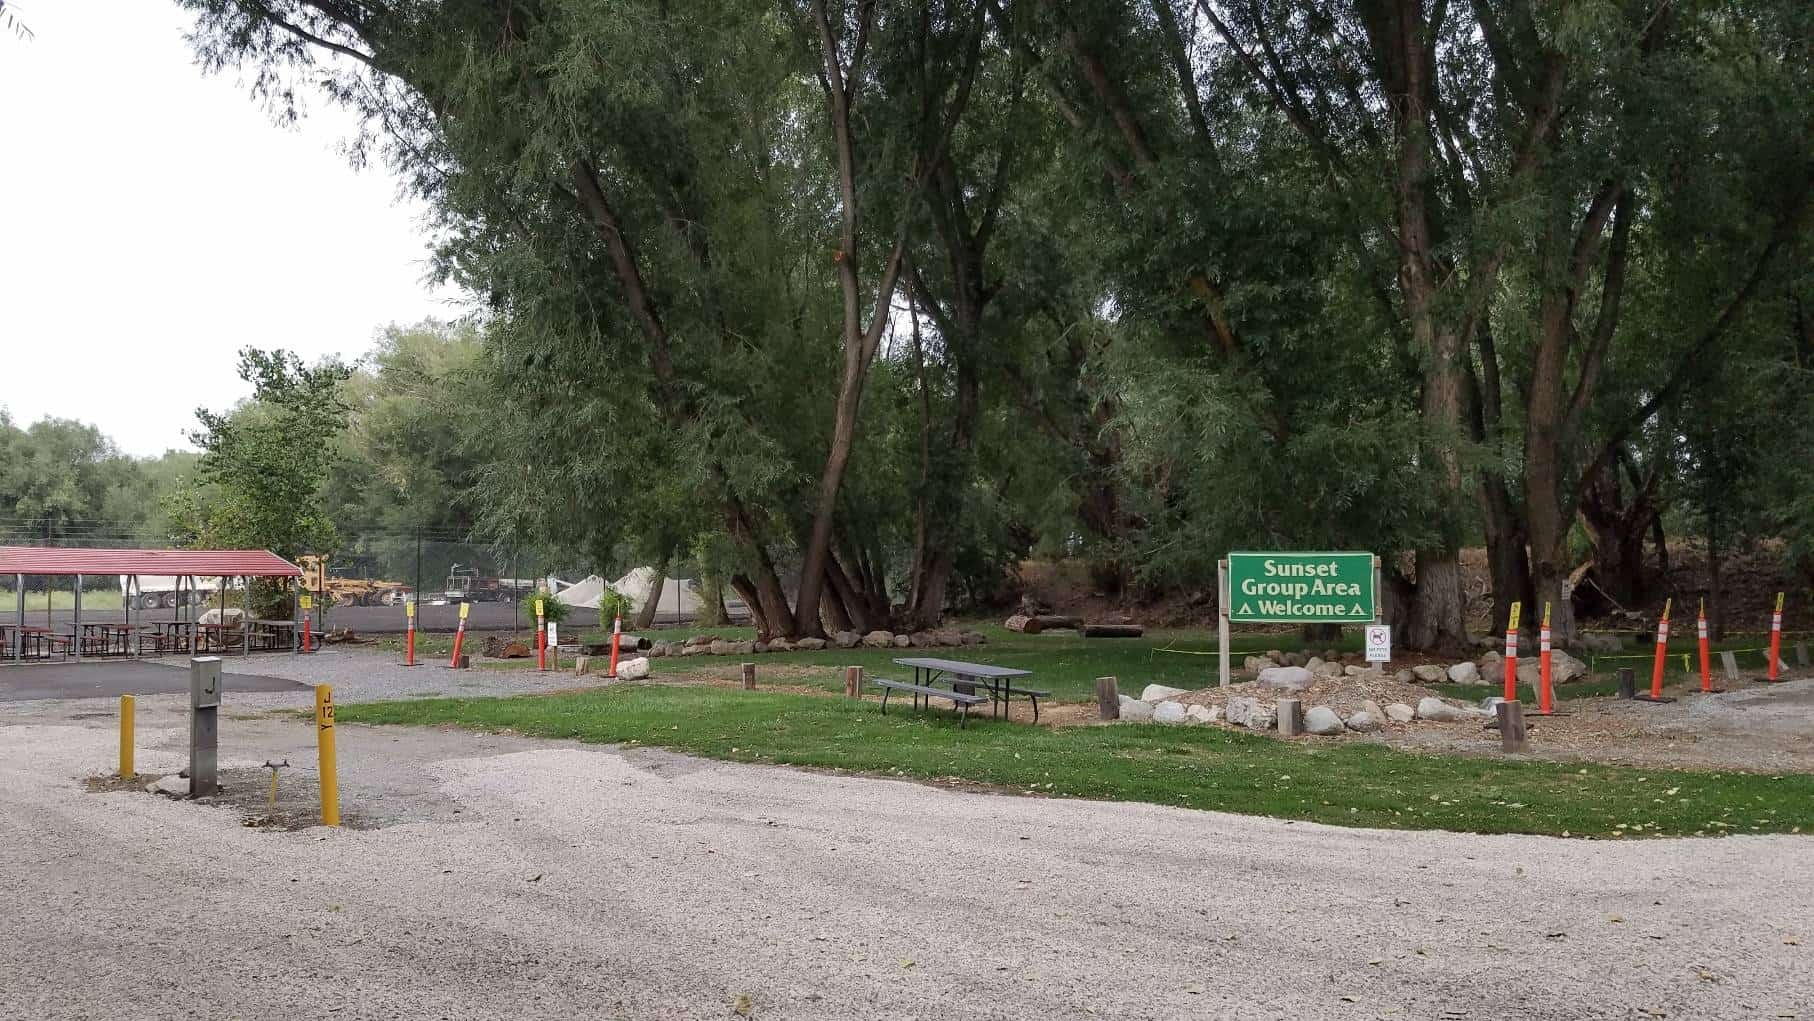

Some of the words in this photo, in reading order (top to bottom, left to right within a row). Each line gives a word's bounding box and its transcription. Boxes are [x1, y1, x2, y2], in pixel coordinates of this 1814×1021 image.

[1264, 559, 1338, 577] Sunset
[1241, 578, 1308, 599] Group
[1311, 578, 1361, 596] Area
[1258, 600, 1346, 616] Welcome
[205, 676, 215, 694] J
[323, 692, 331, 704] J
[322, 706, 333, 718] 12
